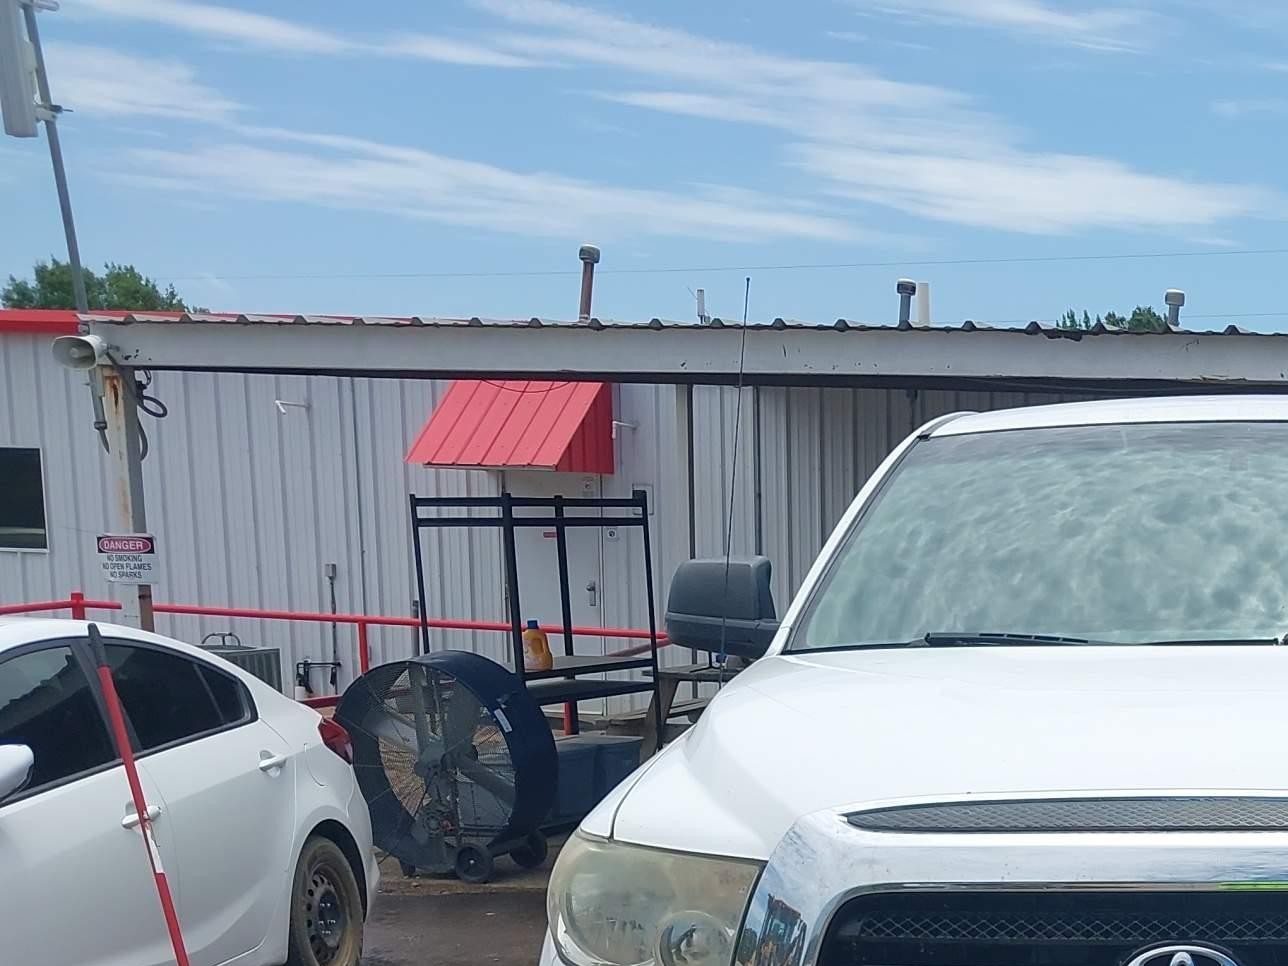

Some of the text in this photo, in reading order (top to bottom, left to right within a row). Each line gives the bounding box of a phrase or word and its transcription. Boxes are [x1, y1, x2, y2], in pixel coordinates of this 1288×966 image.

[103, 540, 144, 550] DANGER
[115, 554, 143, 562] SMOKING
[102, 562, 152, 571] NO OPEN FLAMES
[110, 570, 143, 578] NO SPARKS
